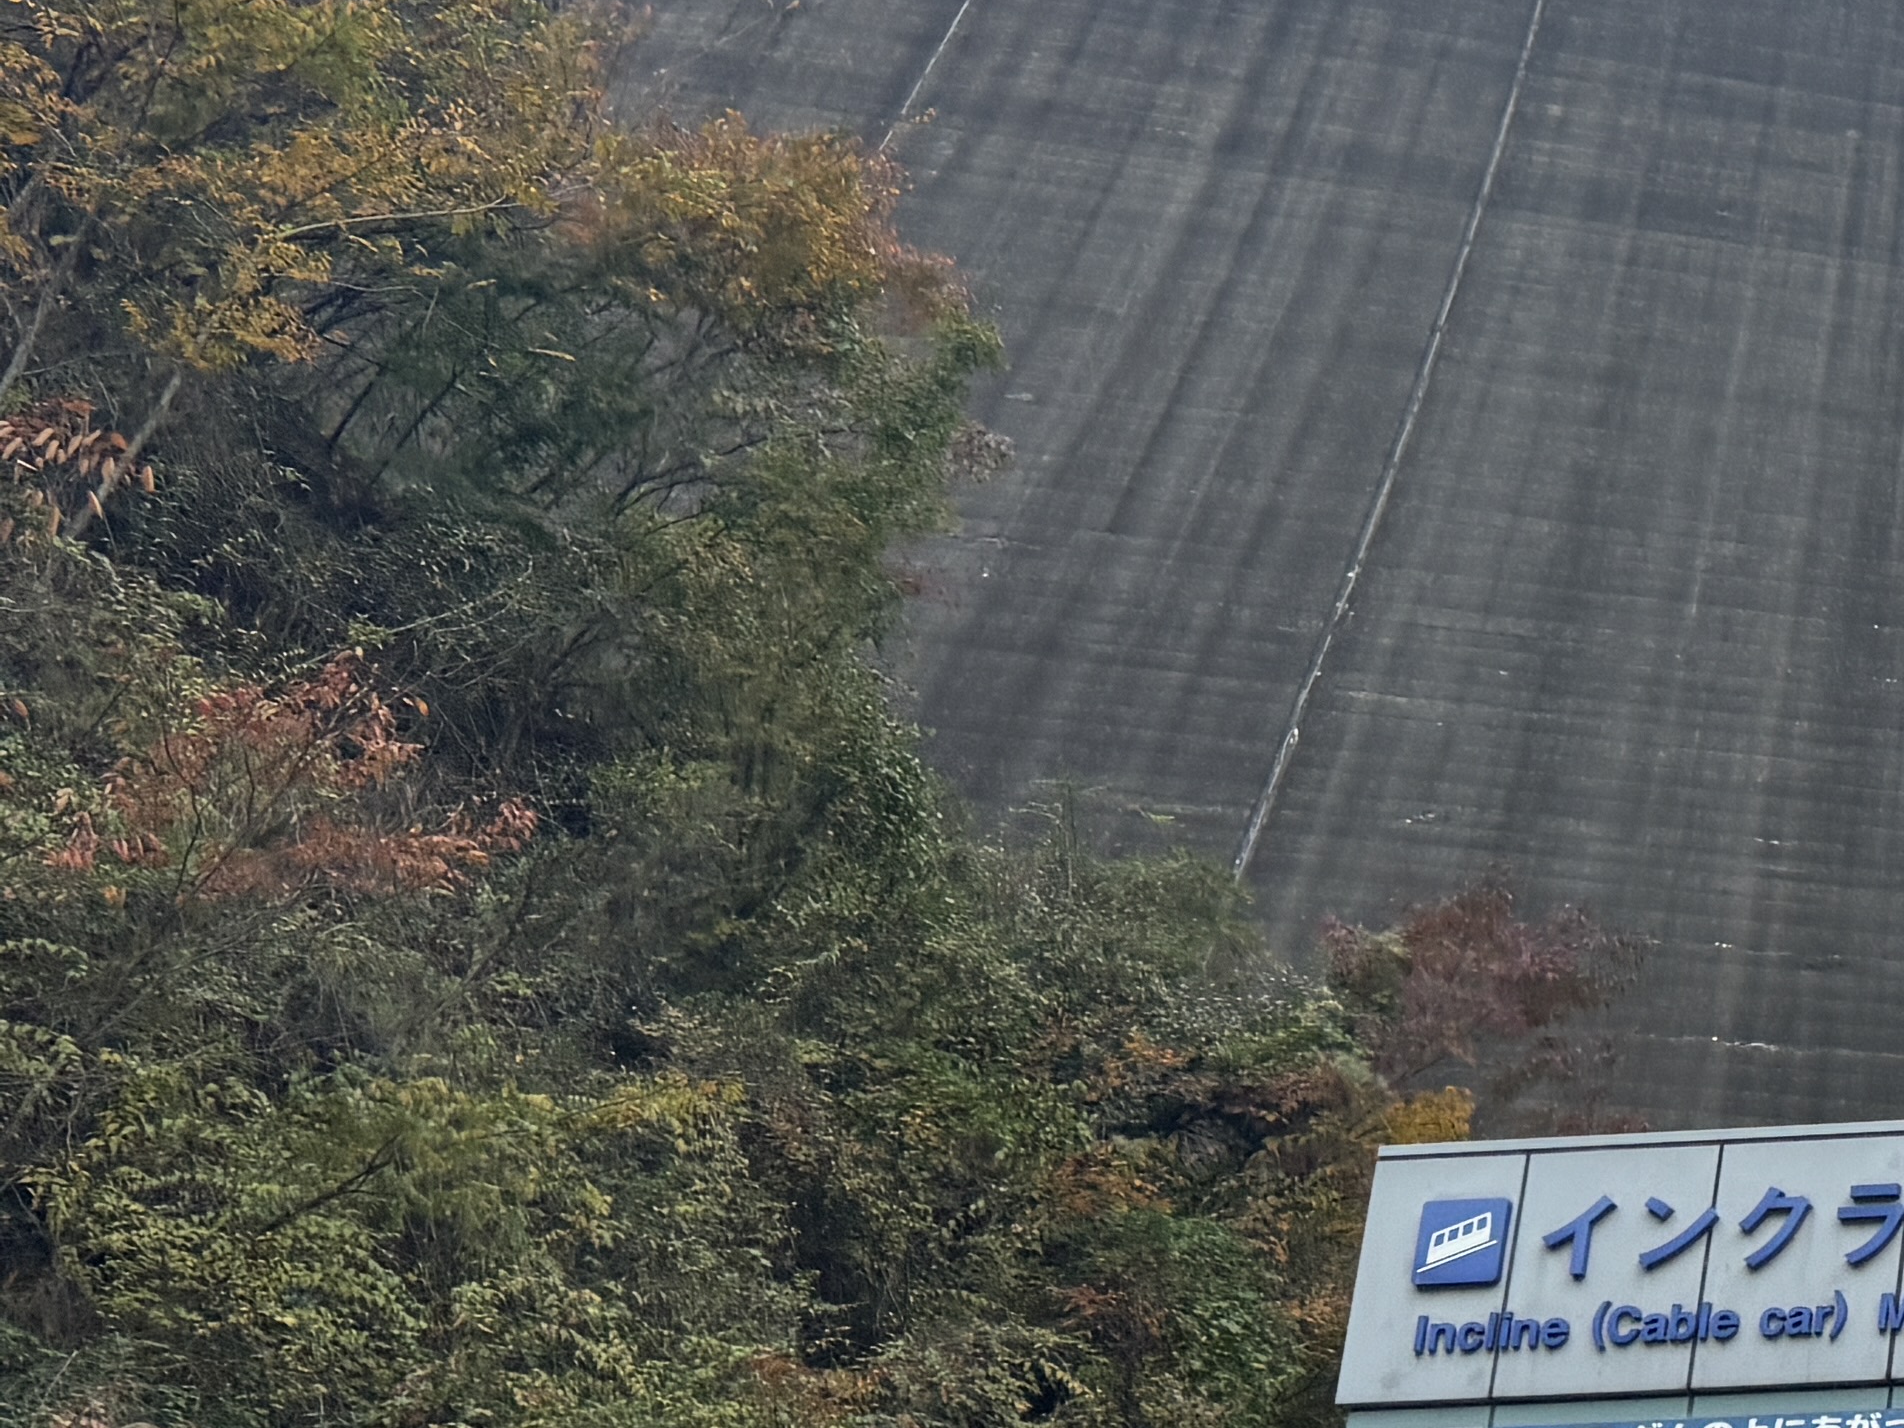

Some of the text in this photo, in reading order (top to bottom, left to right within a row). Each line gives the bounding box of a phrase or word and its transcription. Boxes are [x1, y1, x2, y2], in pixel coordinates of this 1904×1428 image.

[1413, 1311, 1570, 1356] Incline
[1593, 1301, 1740, 1352] (Cable
[1759, 1290, 1848, 1341] car)
